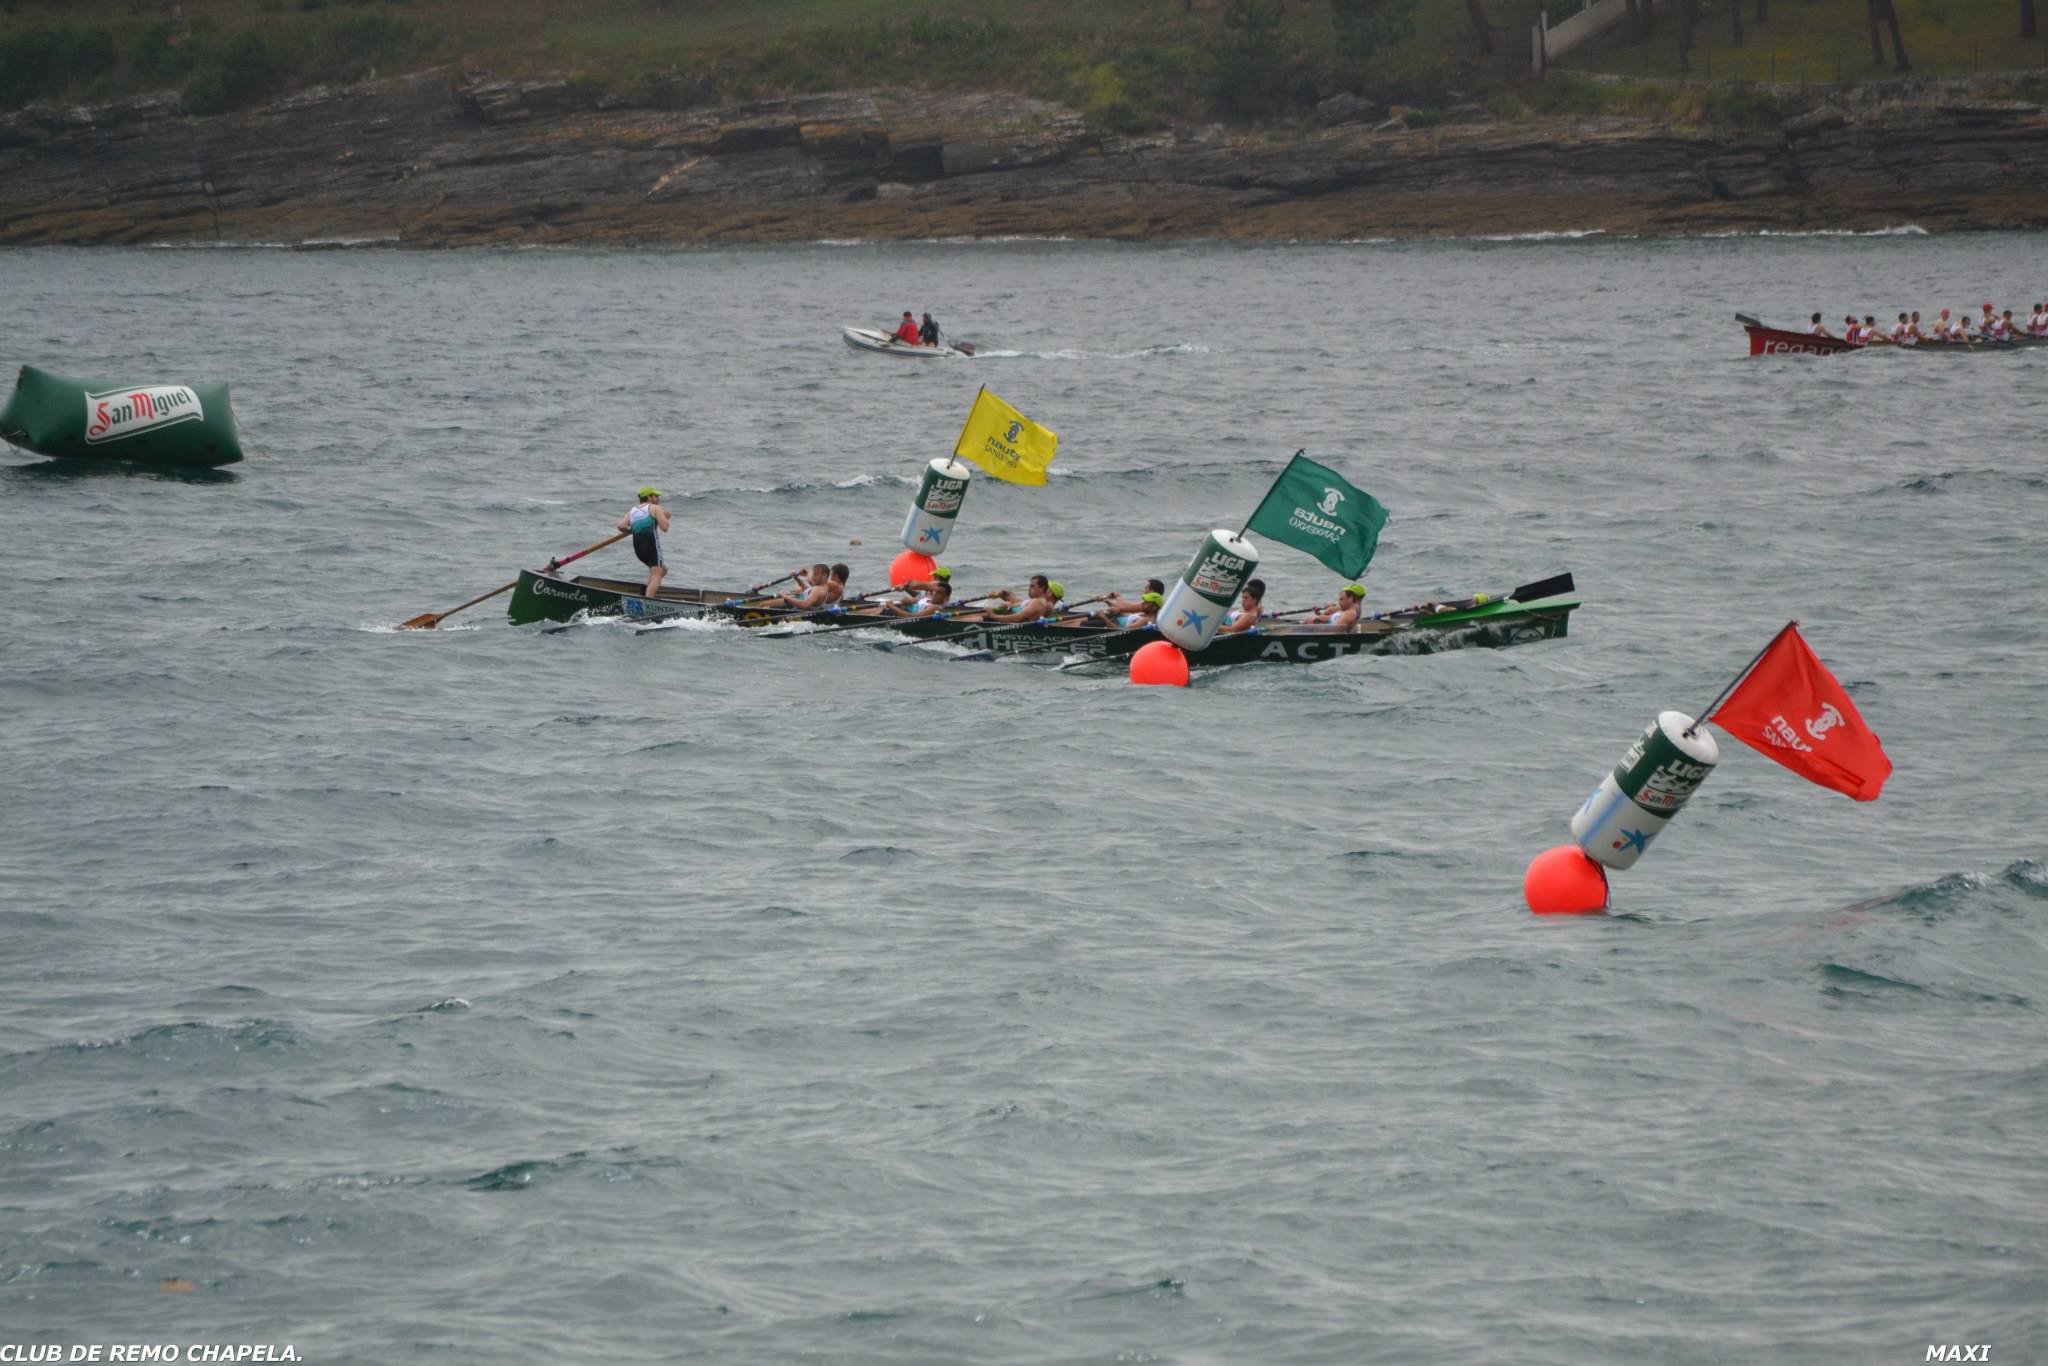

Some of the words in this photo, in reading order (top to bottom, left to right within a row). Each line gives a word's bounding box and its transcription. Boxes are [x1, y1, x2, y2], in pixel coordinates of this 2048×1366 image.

[935, 479, 963, 490] LIGA
[1211, 551, 1246, 571] LIGA
[532, 579, 588, 602] Carmela
